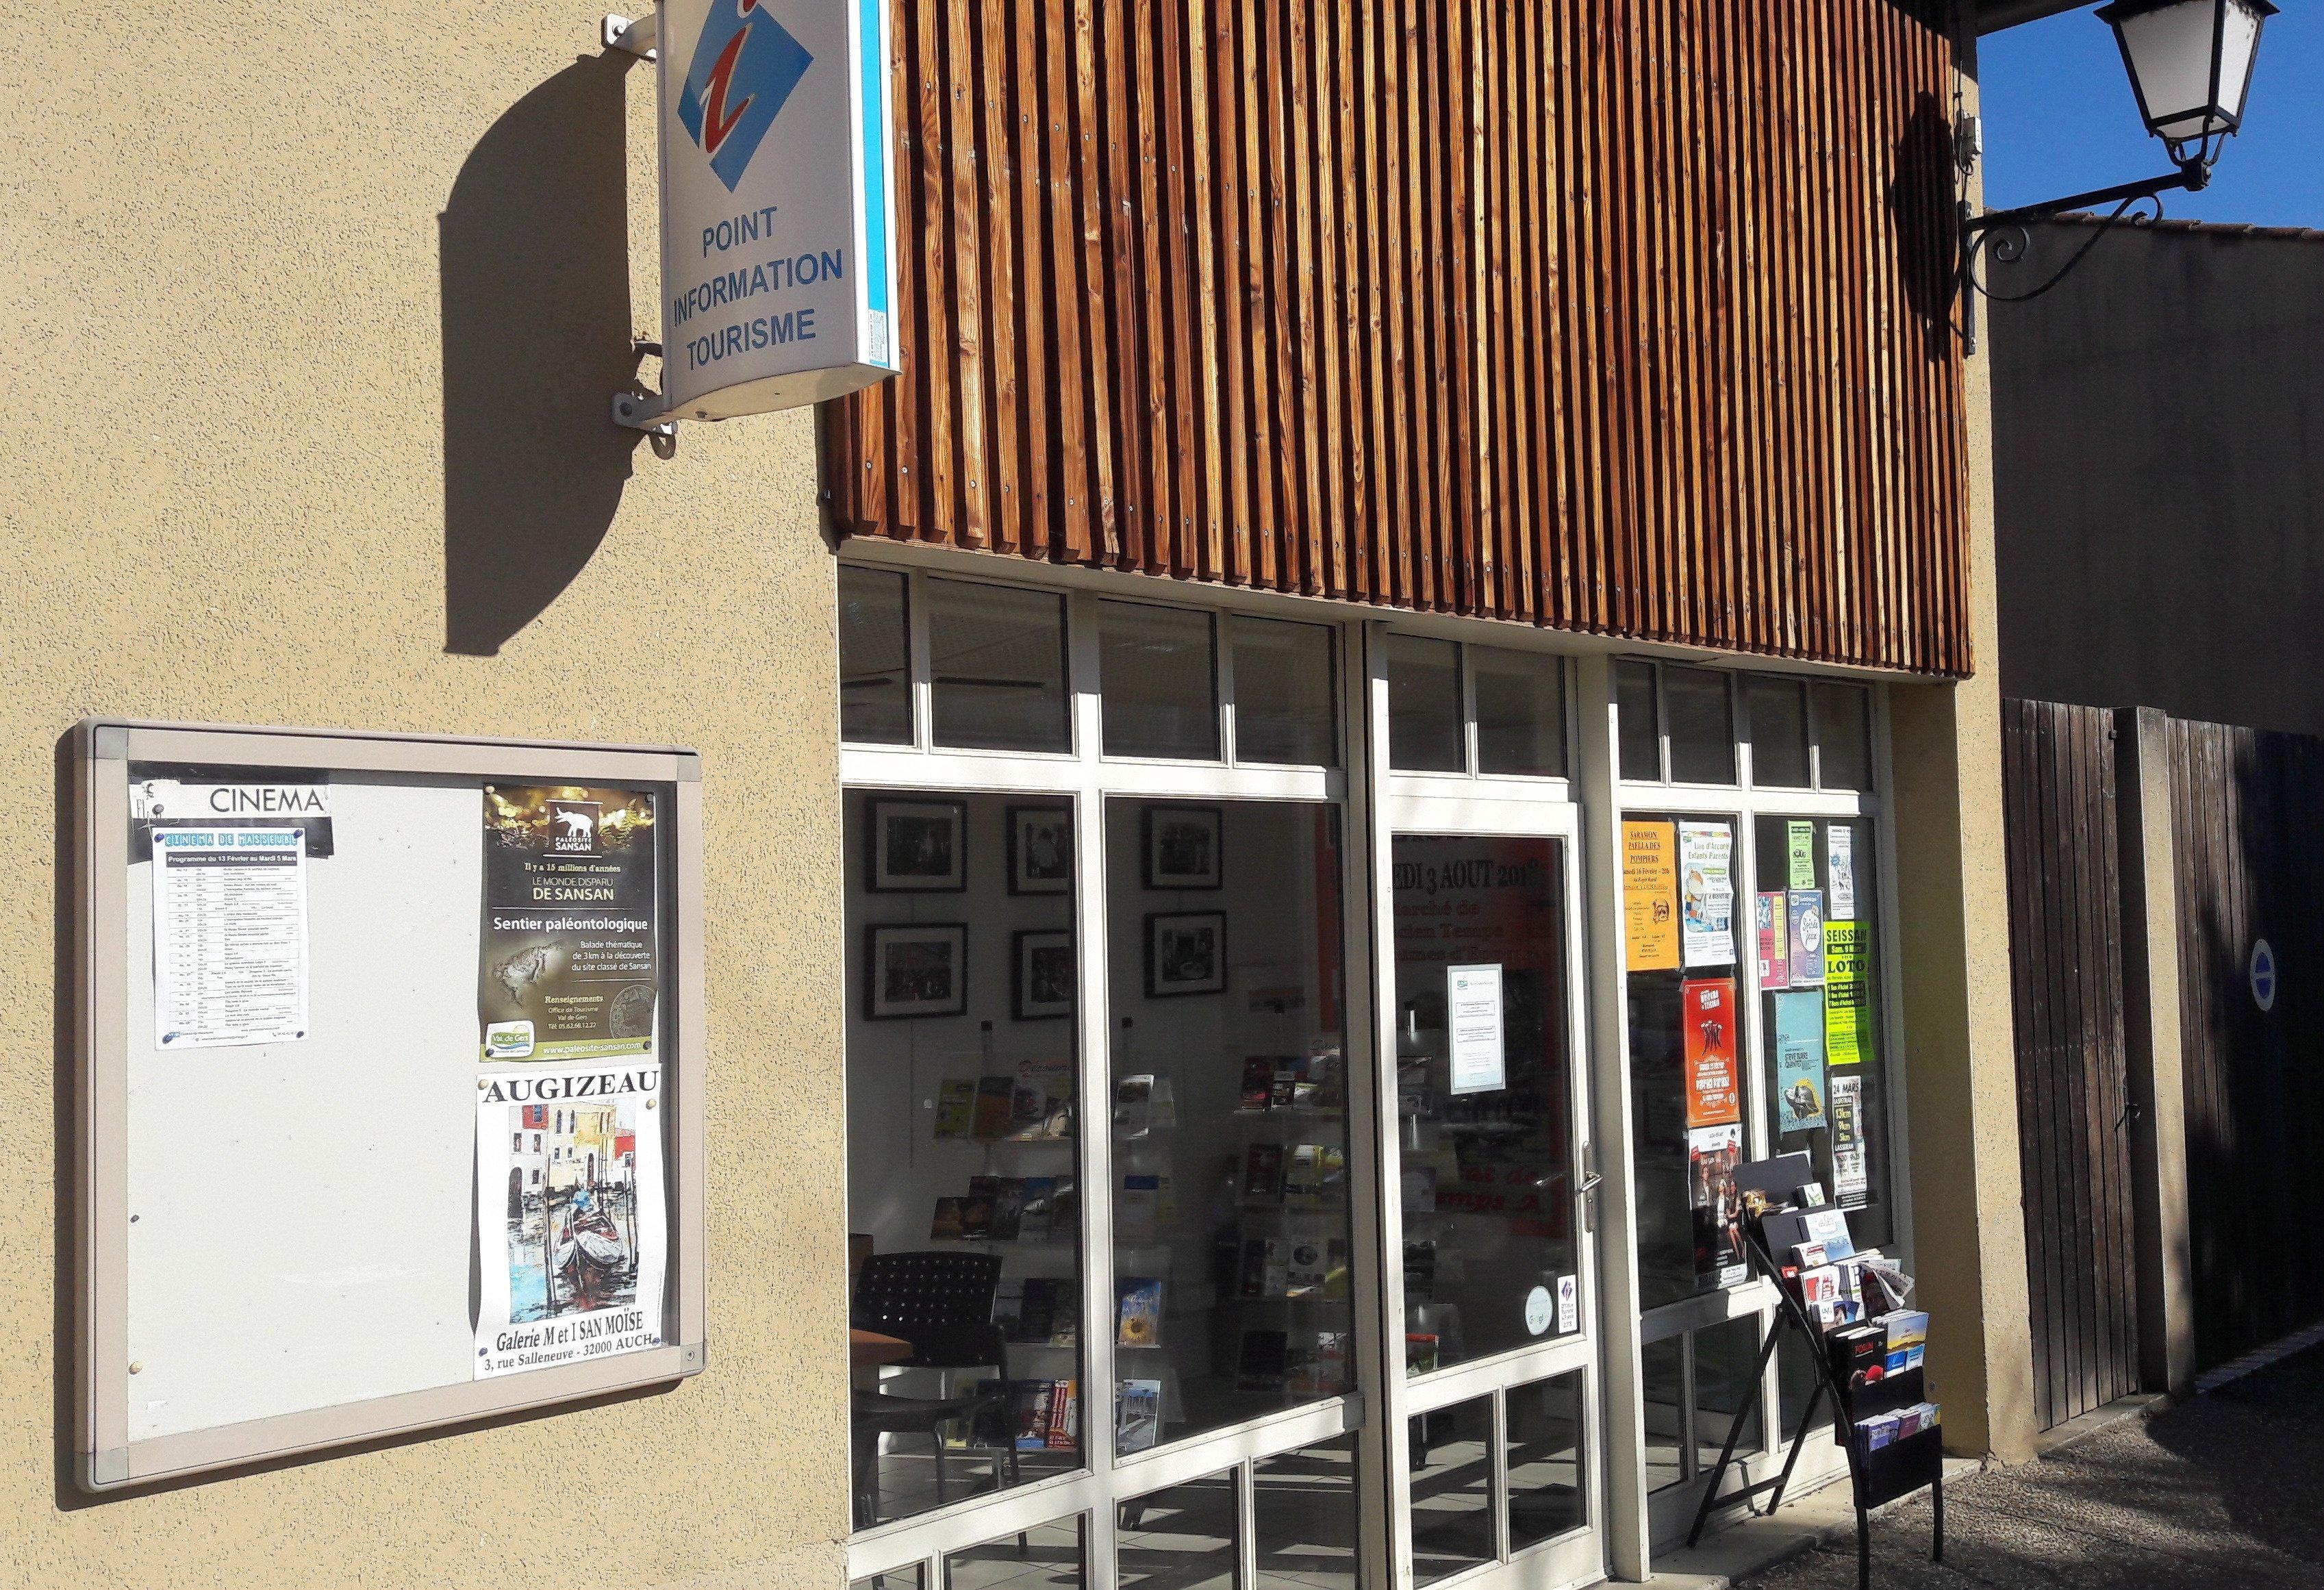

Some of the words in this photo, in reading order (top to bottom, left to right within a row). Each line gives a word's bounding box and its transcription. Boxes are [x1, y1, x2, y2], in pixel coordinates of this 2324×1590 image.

[702, 205, 778, 258] POINT
[673, 248, 843, 328] INFORMATION
[686, 308, 816, 370] TOURISME
[210, 787, 325, 813] CINEMA
[165, 833, 214, 846] CINEMA
[218, 833, 234, 846] DE
[555, 842, 592, 851] SANSAN
[525, 862, 531, 871] Il
[533, 863, 538, 872] y
[546, 863, 555, 871] 15
[557, 863, 588, 872] millions
[1393, 862, 1423, 889] EDI
[1439, 859, 1494, 889] AOUT
[532, 876, 542, 885] LE
[543, 876, 577, 886] MONDE
[533, 887, 552, 900] DE
[554, 887, 614, 900] SANSAN
[493, 917, 542, 930] Sentier
[545, 917, 648, 933] paléontologique
[1826, 929, 1867, 942] SEISSAN
[580, 940, 604, 948] Balade
[605, 940, 643, 950] thématique
[572, 951, 582, 960] de
[601, 951, 605, 959] à
[607, 951, 613, 959] la
[614, 951, 651, 960] découverte
[571, 963, 581, 971] du
[582, 963, 596, 971] site
[596, 962, 618, 971] classé
[618, 962, 628, 970] de
[629, 962, 652, 970] Sansan
[1828, 960, 1865, 973] LOTO
[544, 995, 604, 1005] Renseignements
[543, 1041, 642, 1055] www.paleosite-sansan.com
[482, 1070, 659, 1103] AUGIZEAU
[1833, 1083, 1840, 1094] 24
[1842, 1082, 1859, 1094] MARS
[496, 1328, 540, 1352] Galerie
[542, 1326, 555, 1346] M
[557, 1328, 568, 1344] et
[579, 1317, 602, 1340] SAN
[605, 1307, 644, 1338] MOÏSE
[484, 1359, 494, 1372] 3,
[497, 1359, 515, 1369] rue
[518, 1349, 574, 1366] Salleneuve
[583, 1340, 612, 1356] 32000
[616, 1333, 654, 1350] AUCH
